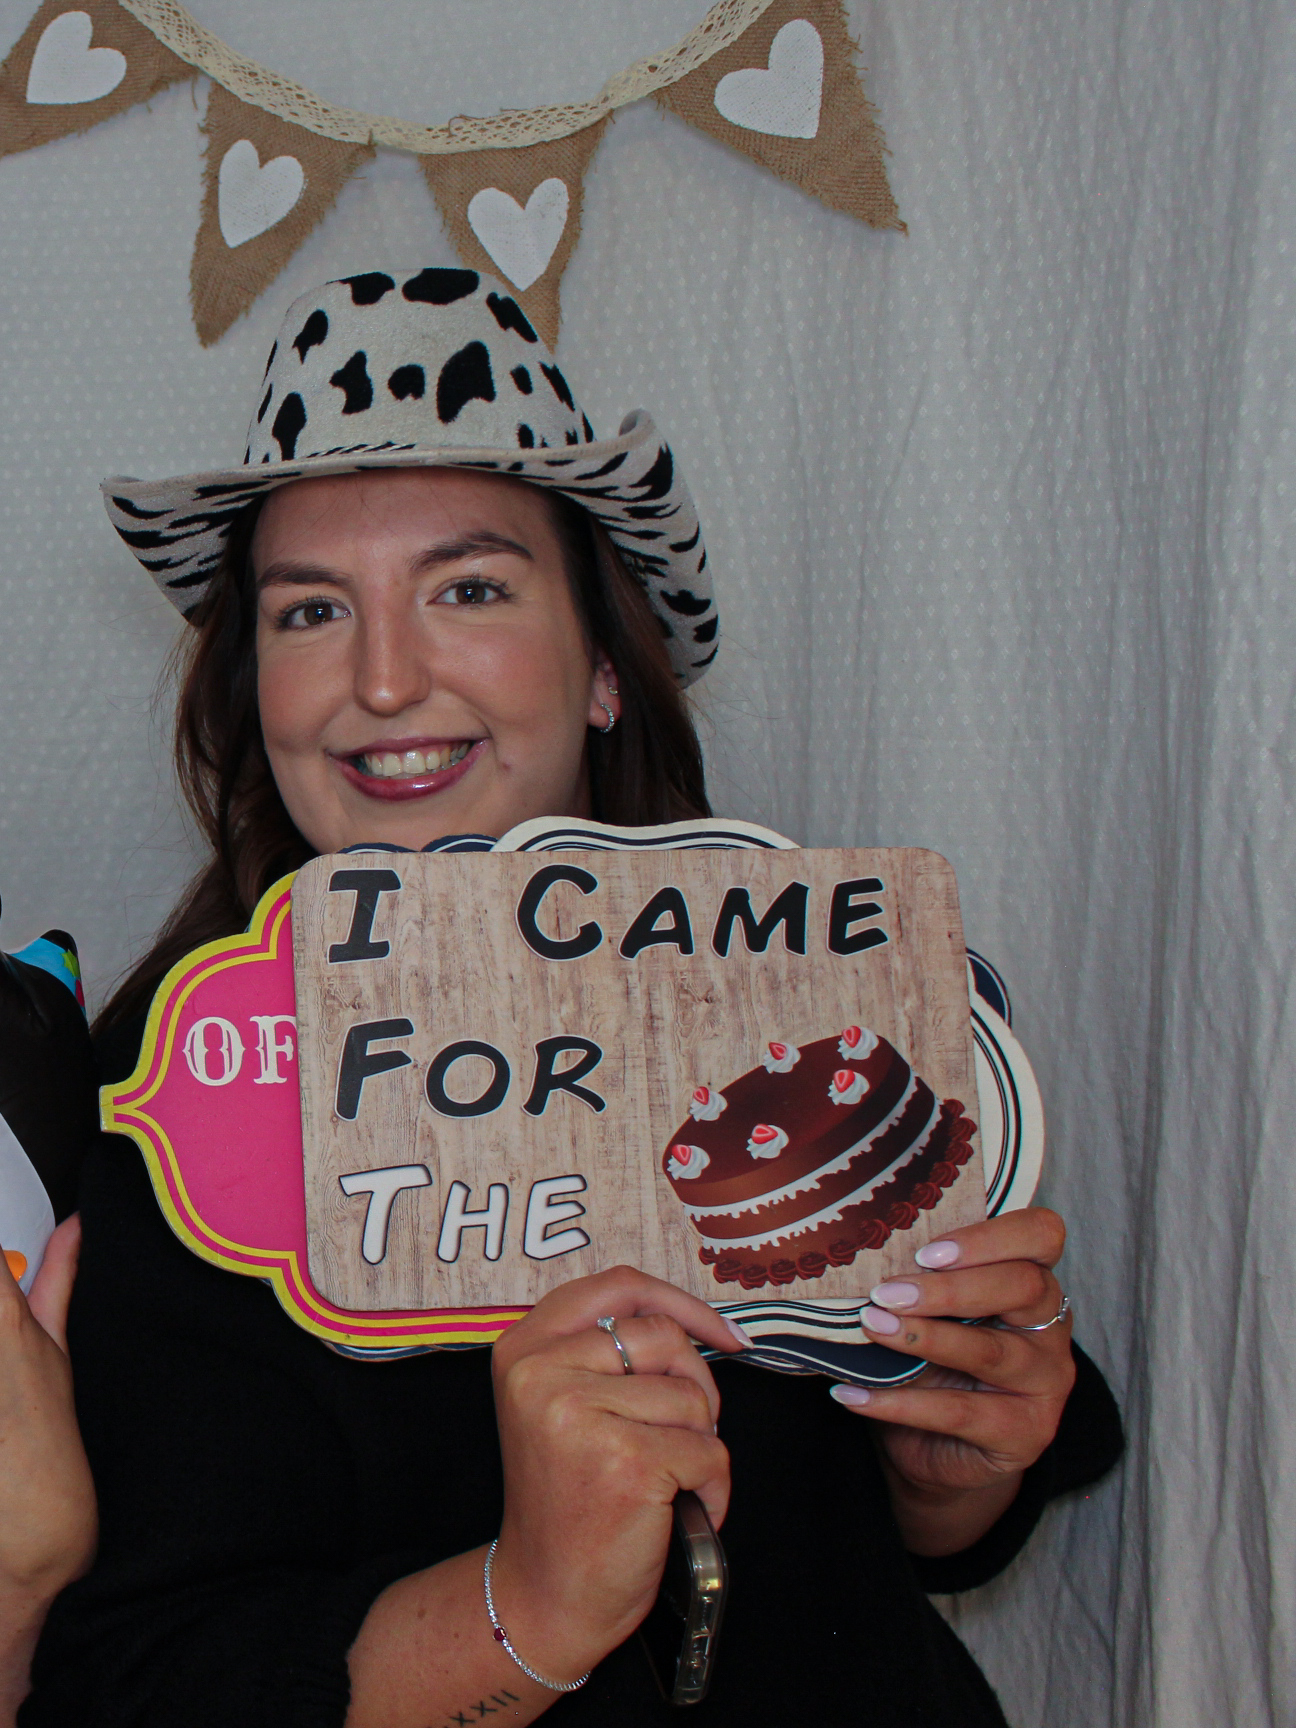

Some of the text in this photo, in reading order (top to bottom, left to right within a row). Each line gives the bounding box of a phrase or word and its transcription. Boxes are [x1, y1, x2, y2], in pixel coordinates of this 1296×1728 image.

[327, 863, 890, 964] I CAME
[334, 1017, 606, 1121] FOR
[338, 1164, 592, 1265] THE
[427, 1689, 521, 1728] XXII
